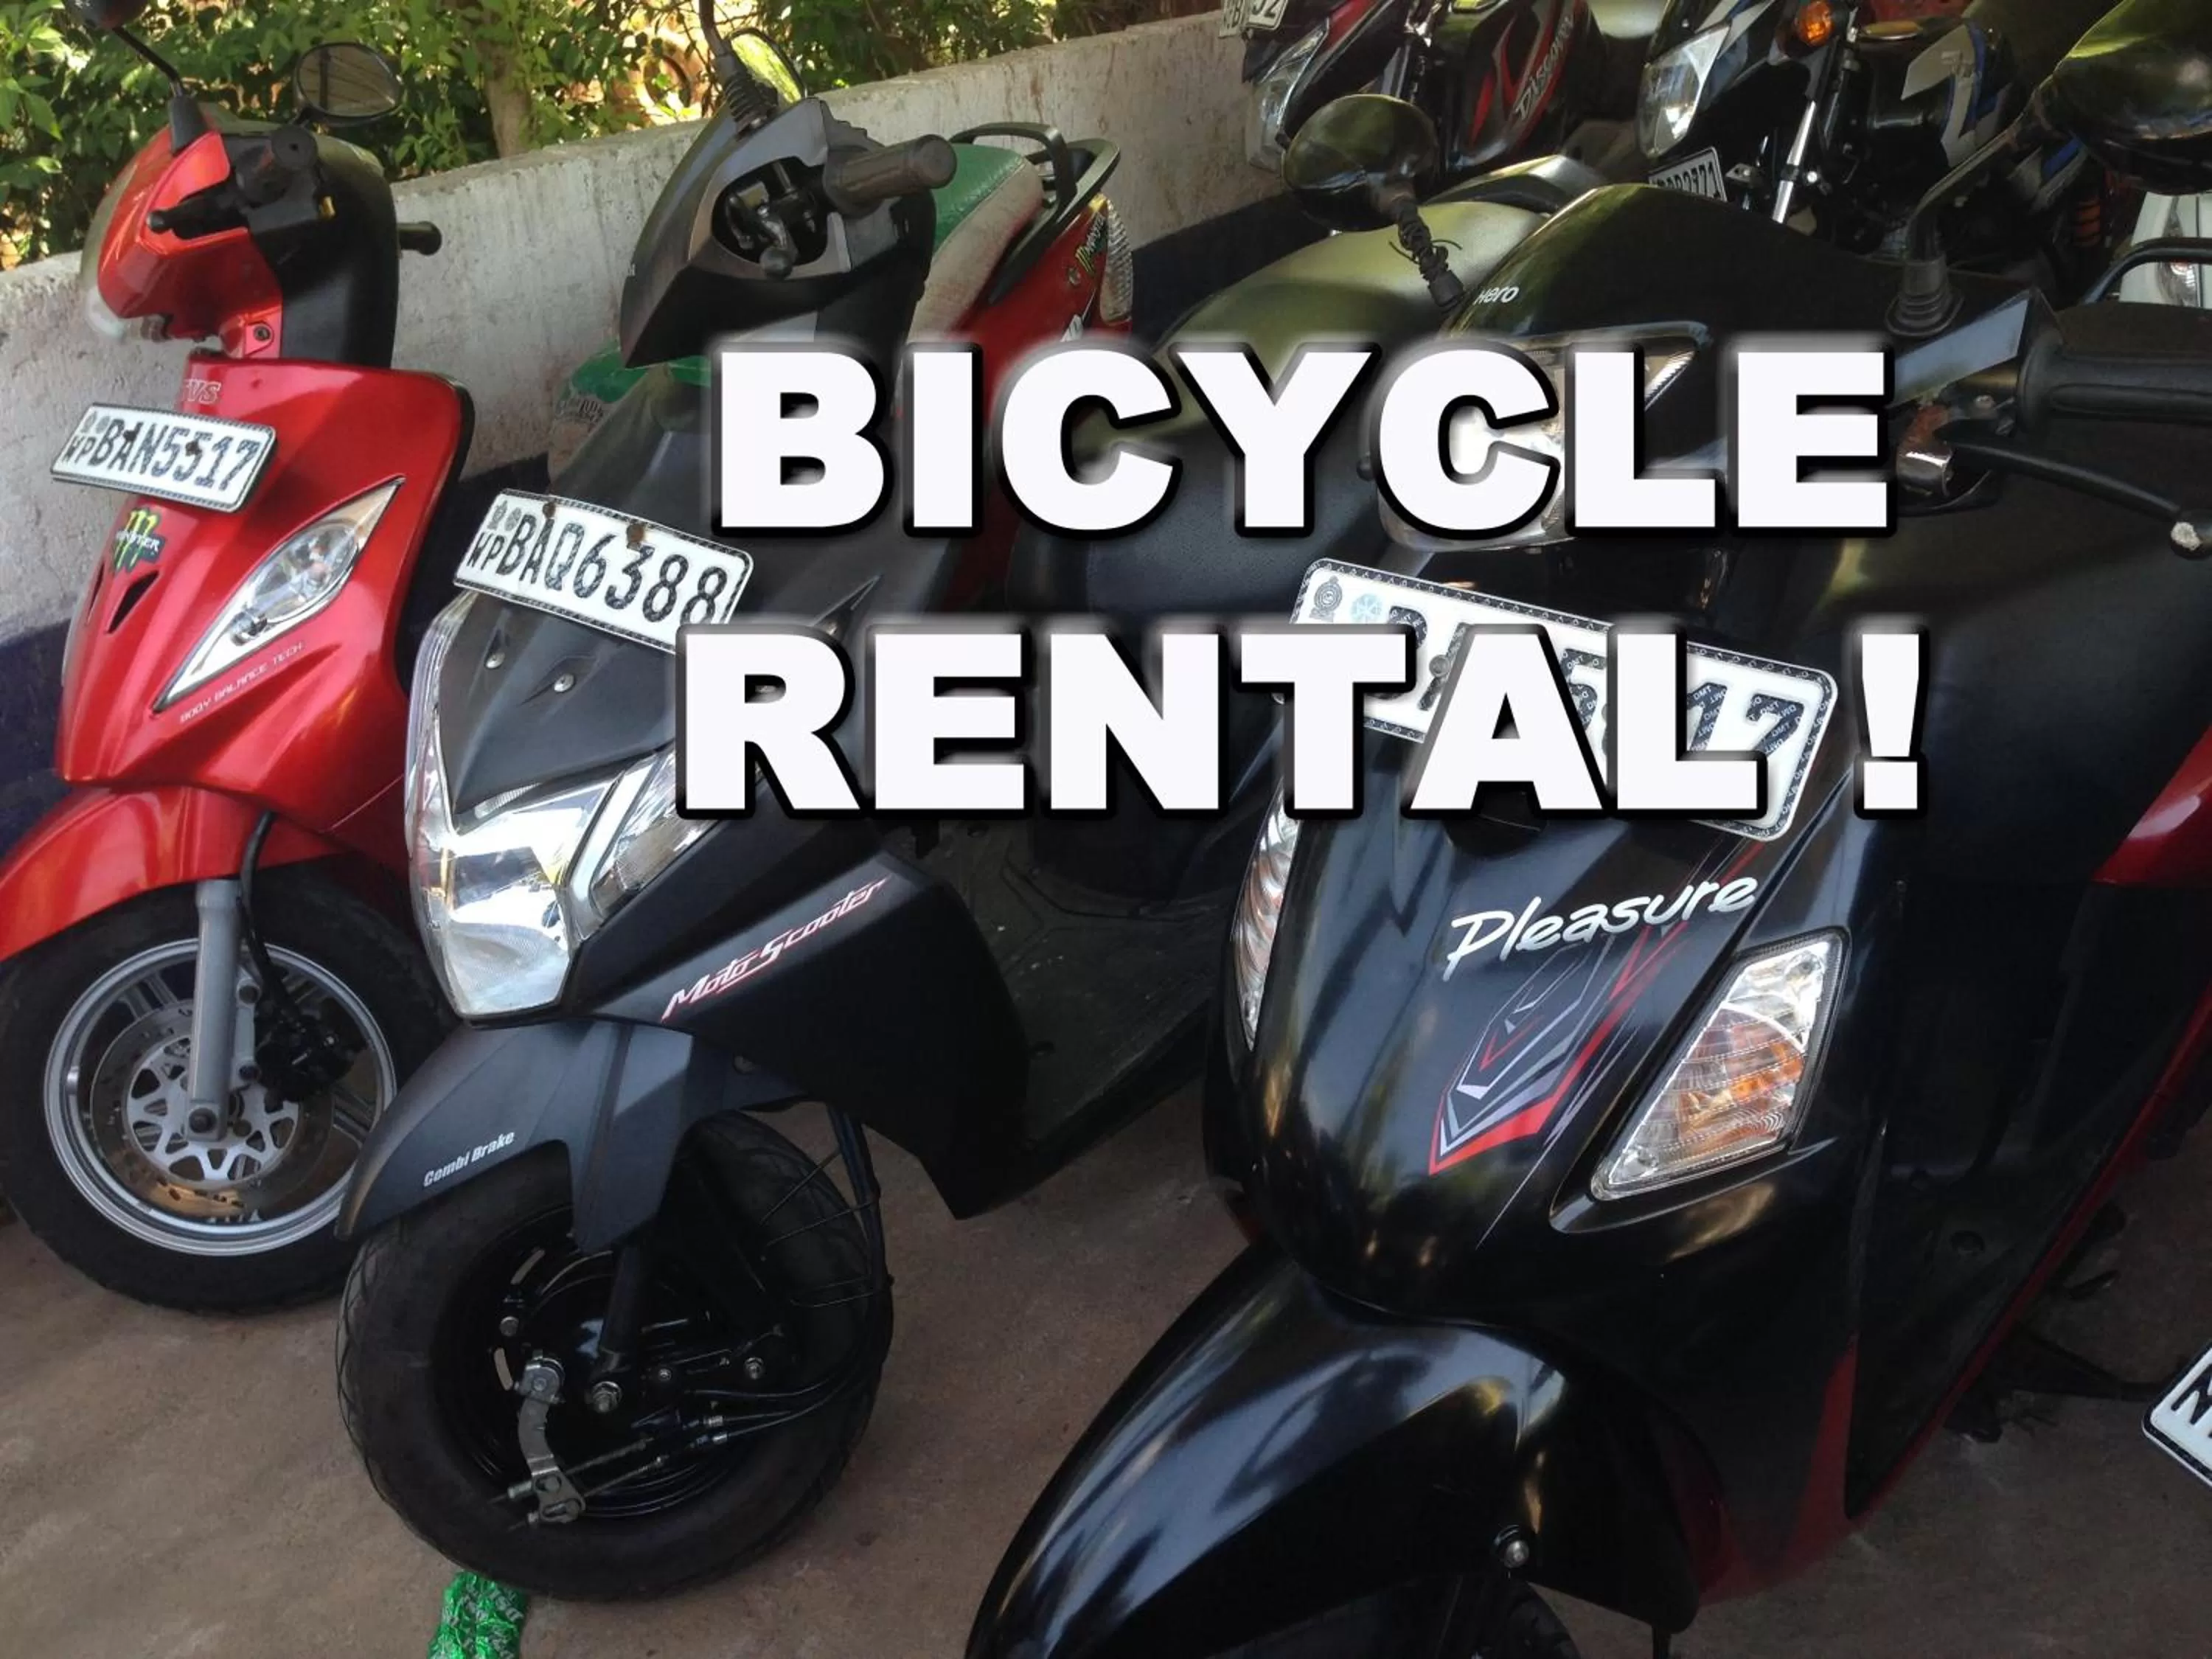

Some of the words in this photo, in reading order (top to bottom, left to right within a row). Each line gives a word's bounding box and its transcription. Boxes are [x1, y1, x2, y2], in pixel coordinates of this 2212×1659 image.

[88, 418, 261, 491] BAN5517
[496, 514, 727, 624] BAQ6388
[1441, 877, 1759, 981] Pleasure
[422, 1151, 470, 1188] Combi
[471, 1132, 515, 1163] Brake
